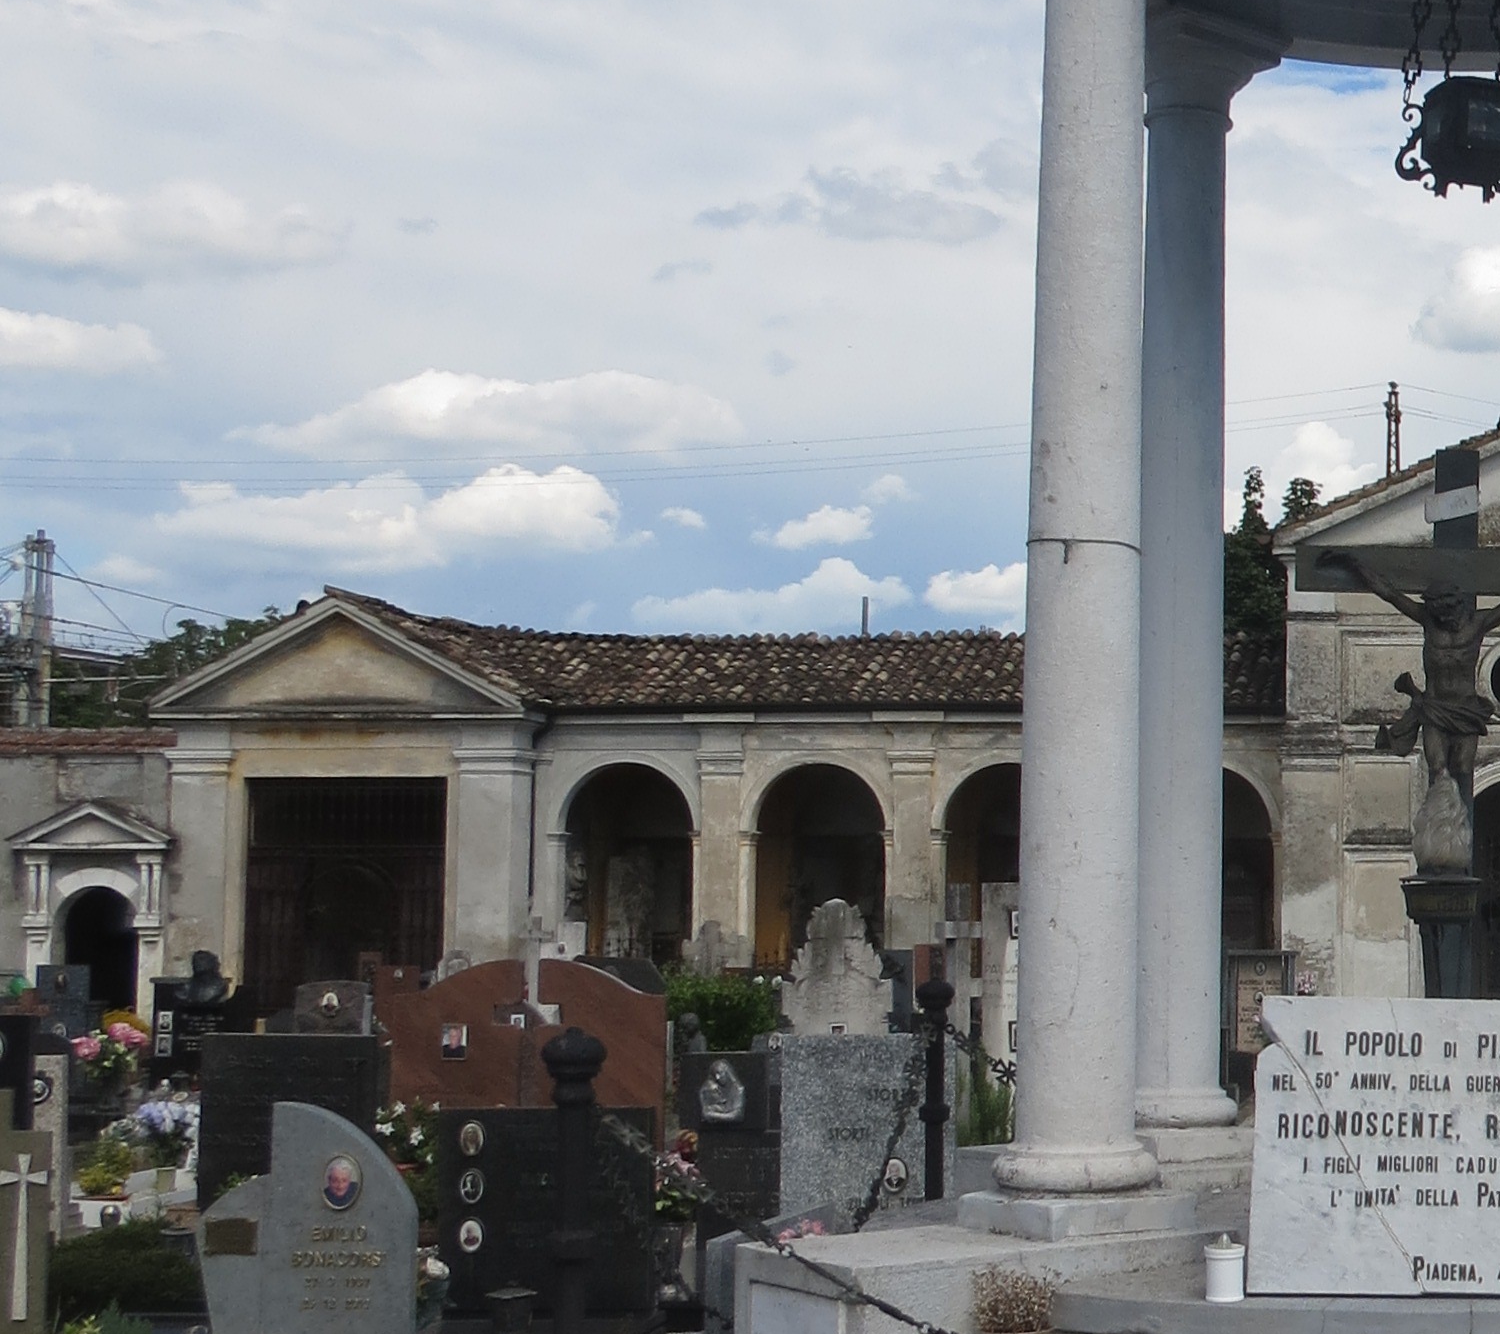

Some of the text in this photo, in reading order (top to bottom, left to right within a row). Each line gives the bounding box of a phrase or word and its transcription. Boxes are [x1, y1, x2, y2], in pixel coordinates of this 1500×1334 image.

[1305, 1029, 1324, 1056] IL
[1345, 1031, 1423, 1057] POPOLO
[1444, 1041, 1458, 1058] DI
[1272, 1073, 1297, 1092] NEL
[1350, 1072, 1397, 1091] ANNIV.
[1409, 1074, 1451, 1092] DELLA
[1277, 1110, 1461, 1142] RICONOSCENTE,
[1303, 1157, 1308, 1174] I
[1324, 1155, 1362, 1174] FIGLI
[1377, 1156, 1439, 1174] MIGLIORI
[1416, 1188, 1459, 1208] DELLA
[311, 1225, 368, 1242] EMILIO
